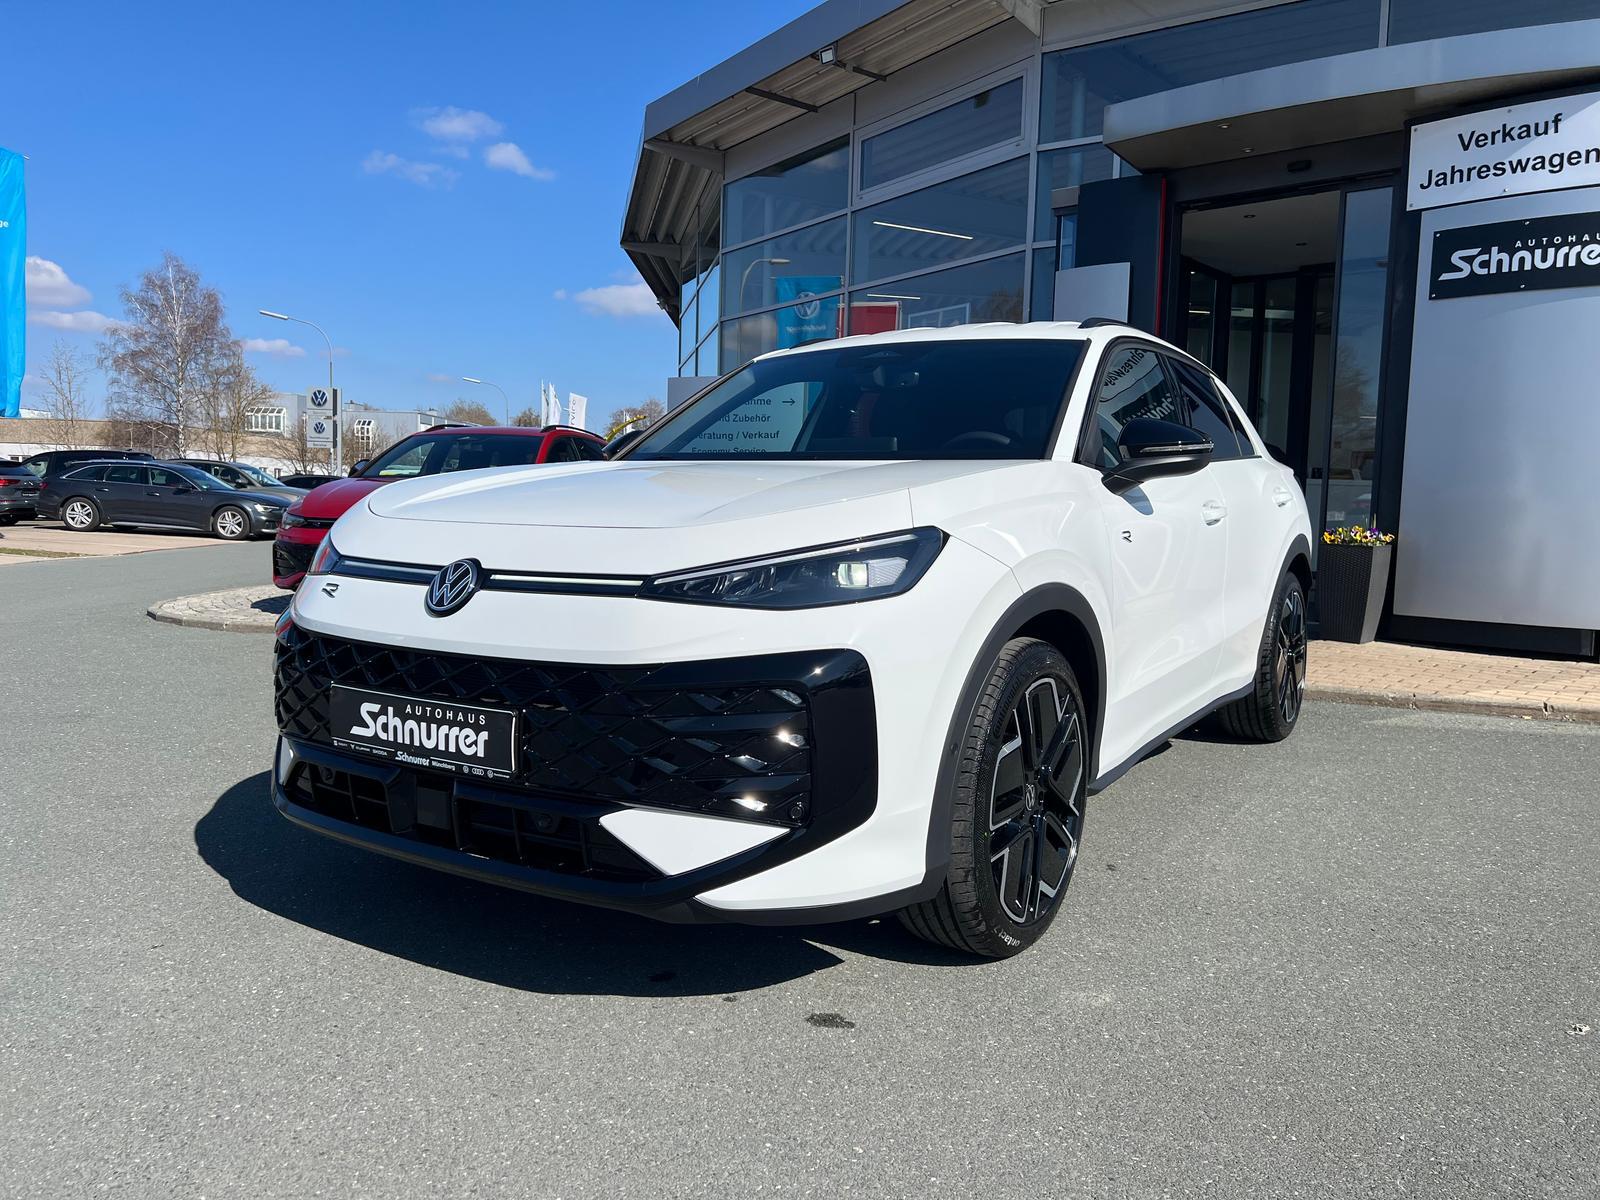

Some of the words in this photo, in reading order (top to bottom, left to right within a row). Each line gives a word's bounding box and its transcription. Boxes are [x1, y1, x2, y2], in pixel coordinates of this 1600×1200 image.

[1458, 113, 1563, 152] Verkauf
[1419, 147, 1600, 190] Jahreswagen
[733, 413, 771, 423] Zubehör
[742, 430, 780, 439] Verkauf
[405, 704, 486, 725] AUTOHAUS
[350, 702, 489, 758] Schnurrer
[395, 751, 430, 766] Schnurrer
